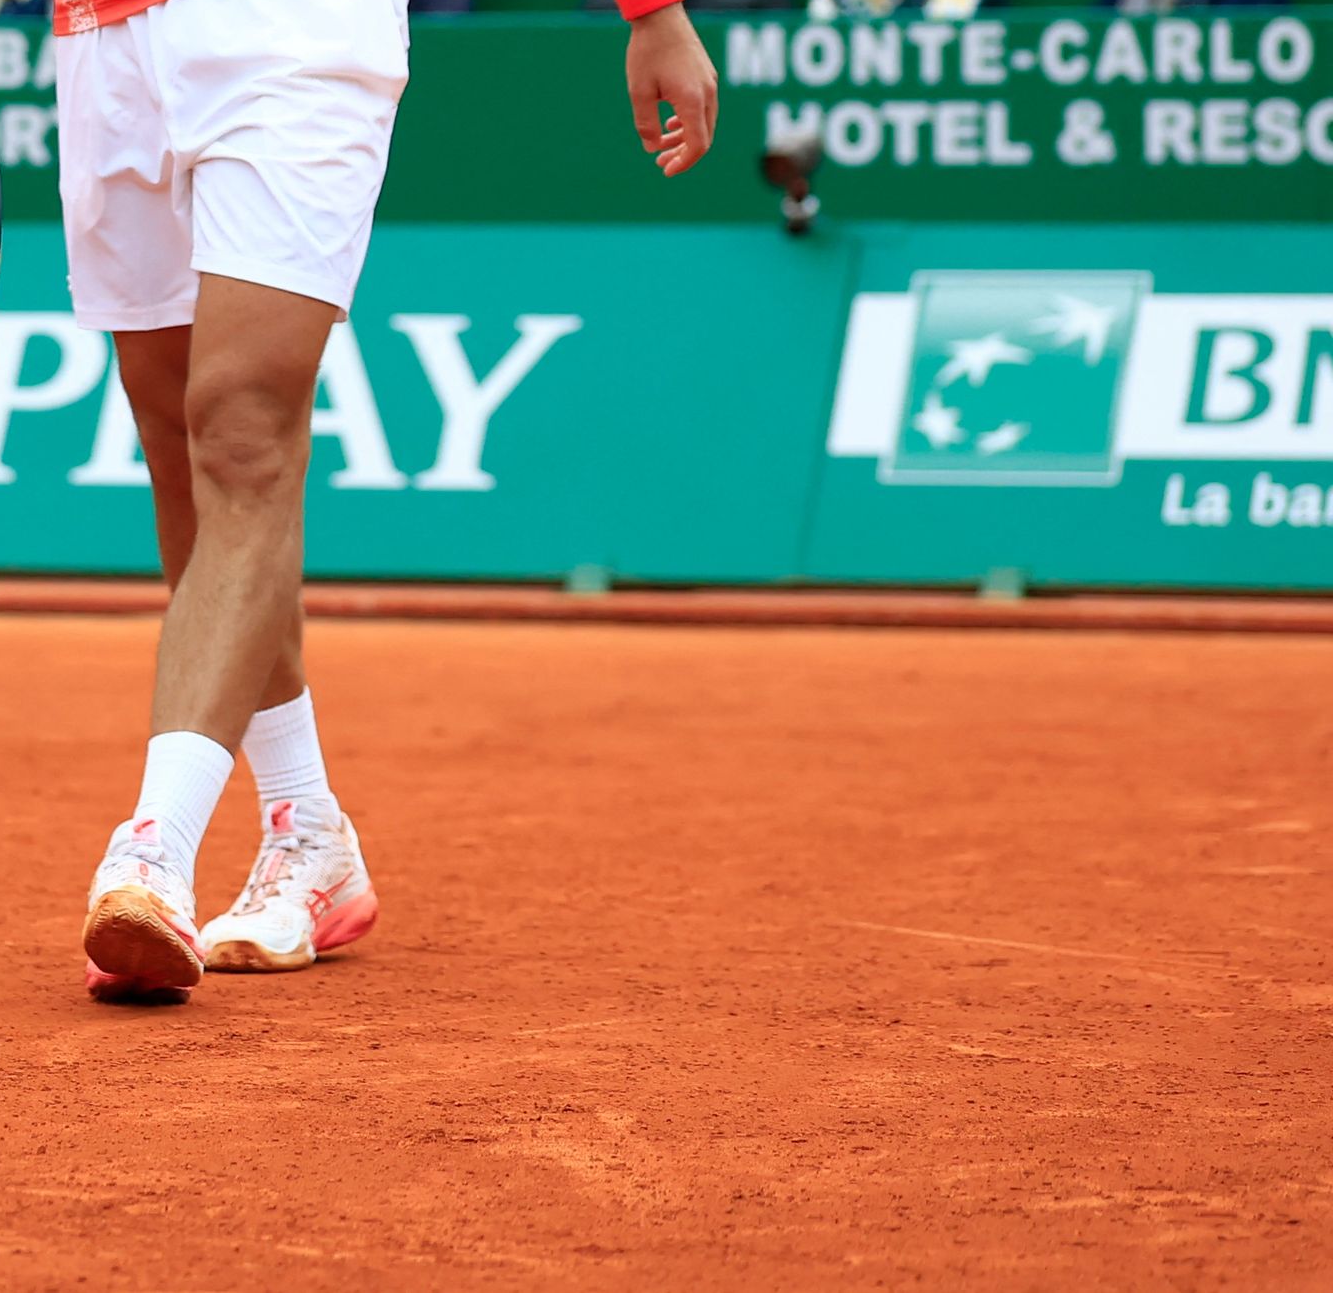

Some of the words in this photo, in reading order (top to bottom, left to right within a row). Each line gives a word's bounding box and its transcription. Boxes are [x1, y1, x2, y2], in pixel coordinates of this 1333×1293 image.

[728, 18, 1315, 86] MONTE-CARLO
[1056, 99, 1117, 166] &
[1161, 472, 1232, 528] La
